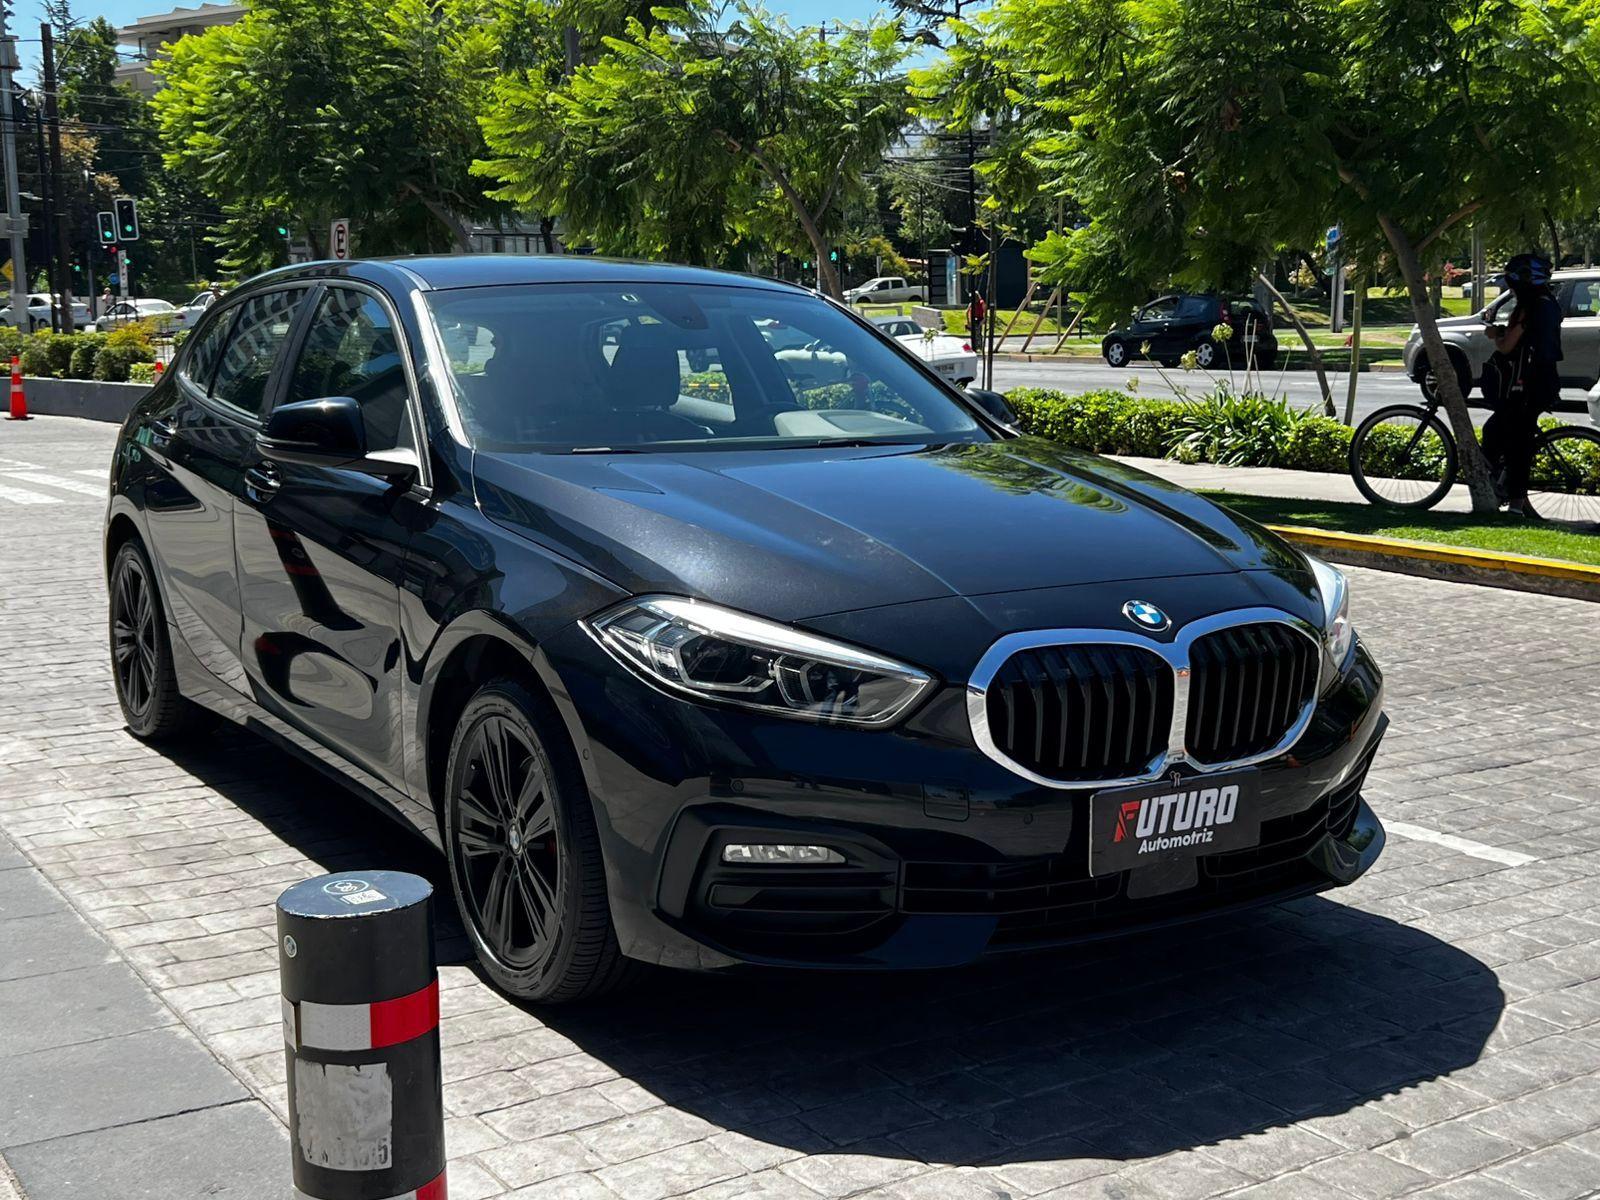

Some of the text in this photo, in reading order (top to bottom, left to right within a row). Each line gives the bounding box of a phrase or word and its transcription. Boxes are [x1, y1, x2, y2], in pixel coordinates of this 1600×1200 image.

[337, 230, 345, 253] E
[1114, 785, 1239, 842] FUTURO
[1138, 828, 1213, 854] Automotriz
